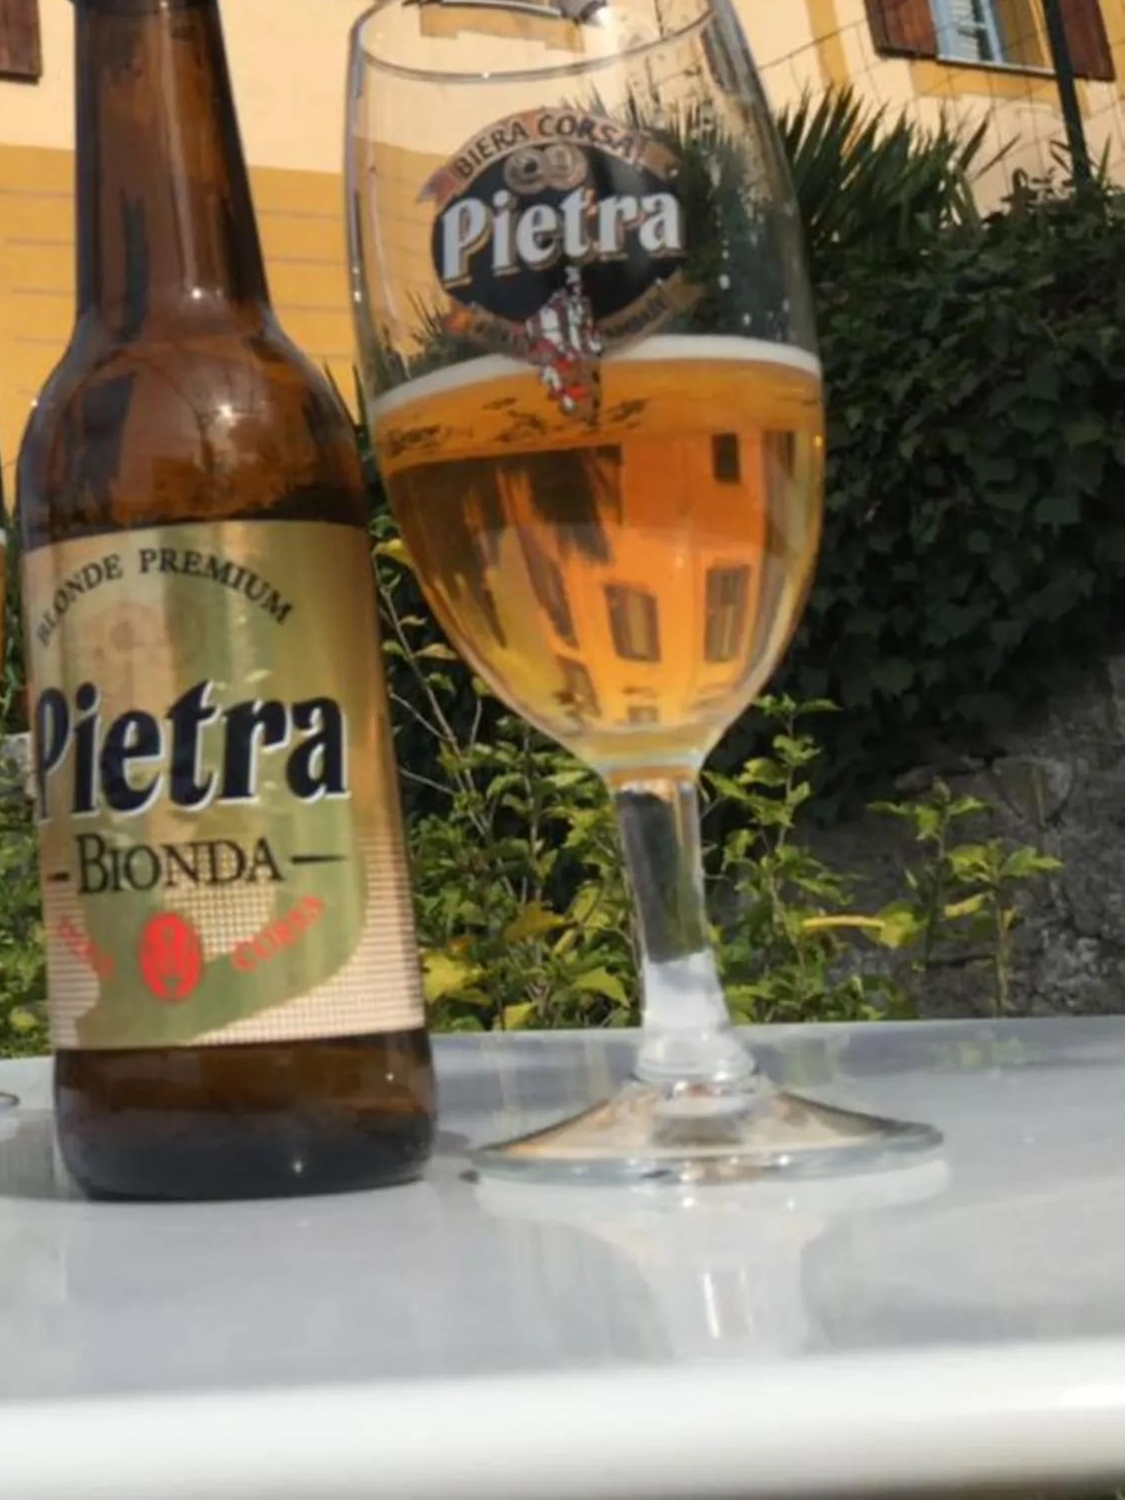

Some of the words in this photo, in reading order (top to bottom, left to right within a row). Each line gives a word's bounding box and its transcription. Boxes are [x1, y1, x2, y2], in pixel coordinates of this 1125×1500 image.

[457, 119, 529, 179] BIERA
[537, 114, 639, 160] CORSA
[442, 188, 685, 288] Pietra
[35, 553, 124, 647] BLONDE
[138, 547, 294, 626] PREMIUM
[35, 678, 352, 825] Pietra
